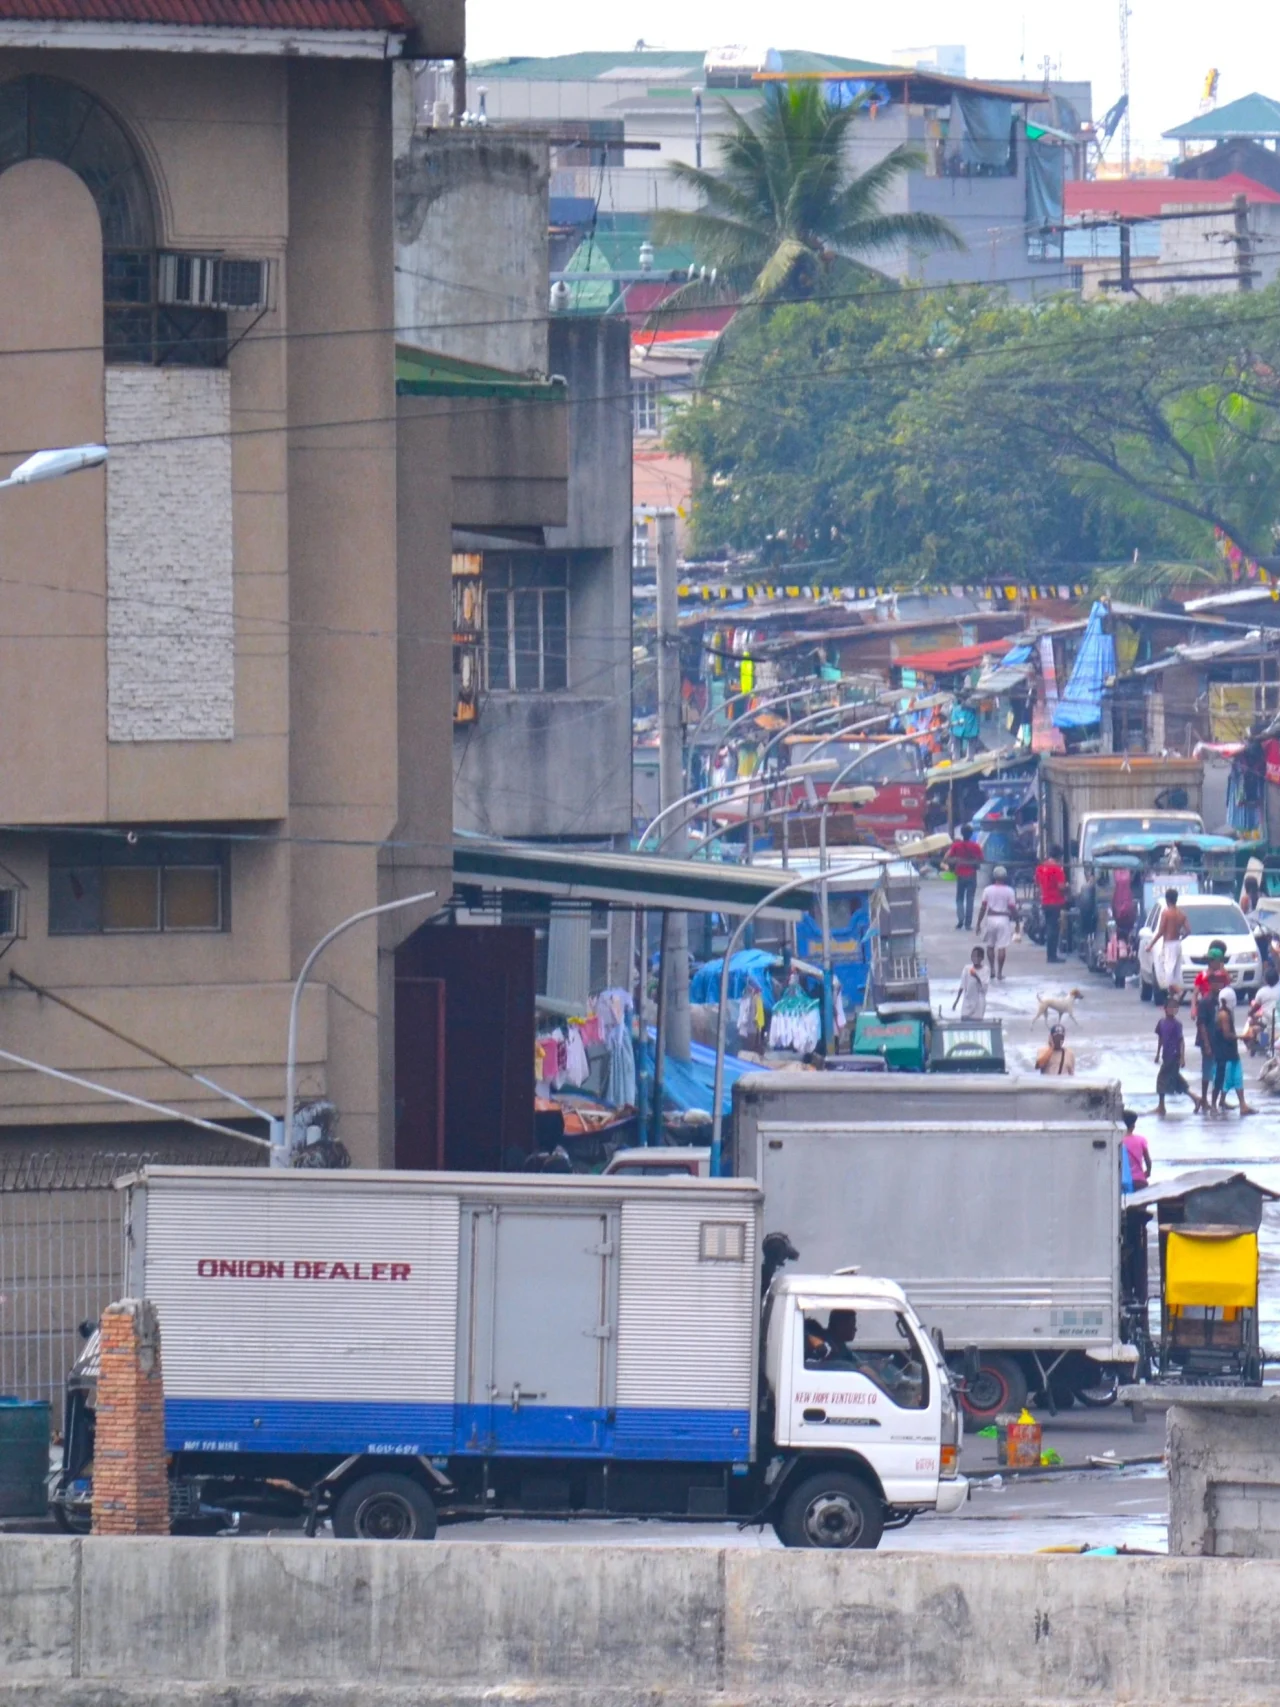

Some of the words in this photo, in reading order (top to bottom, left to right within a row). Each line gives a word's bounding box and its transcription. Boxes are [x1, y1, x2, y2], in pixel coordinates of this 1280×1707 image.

[197, 1258, 284, 1279] ONION
[293, 1260, 411, 1281] DEALER
[794, 1391, 811, 1404] NEW
[812, 1391, 830, 1404] HOPE
[831, 1391, 866, 1405] VENTURES
